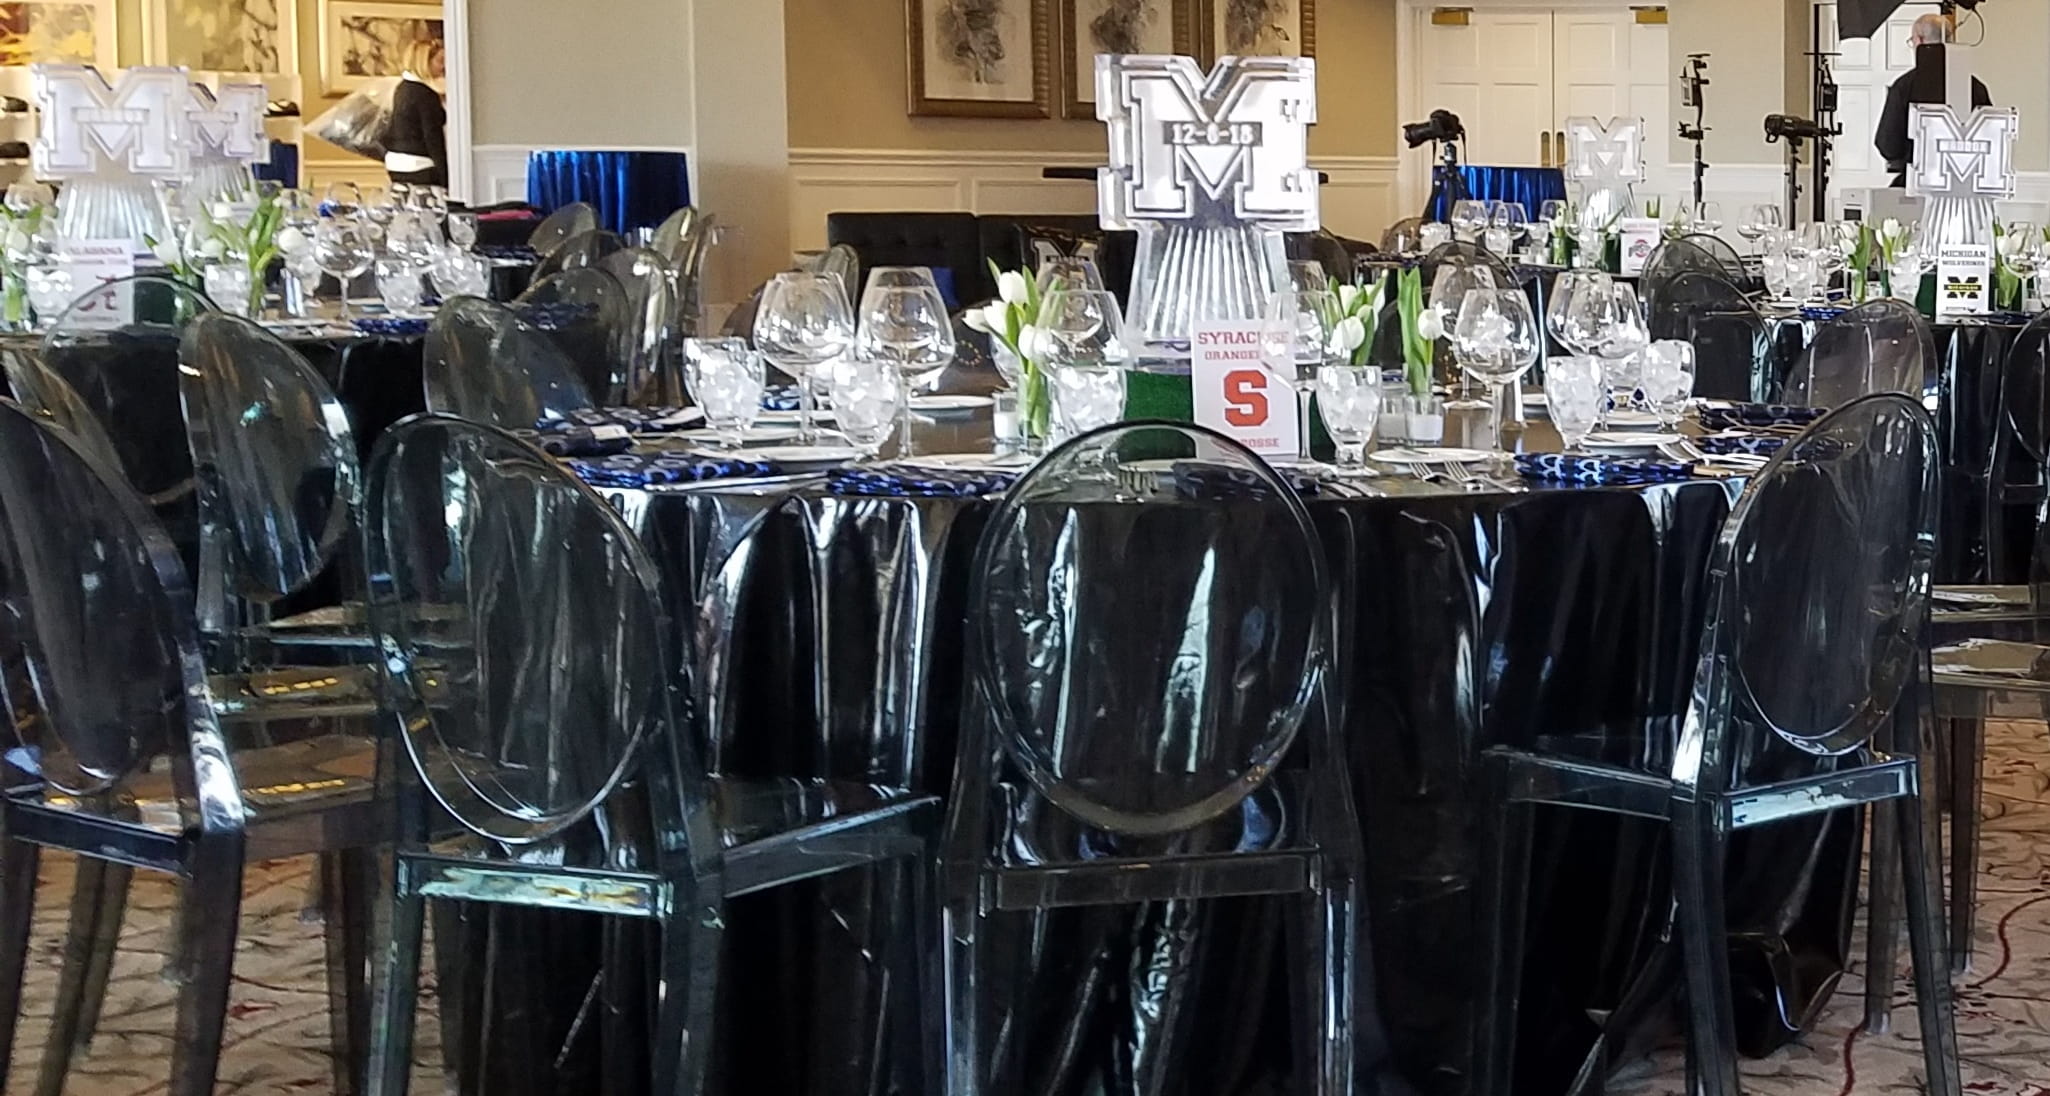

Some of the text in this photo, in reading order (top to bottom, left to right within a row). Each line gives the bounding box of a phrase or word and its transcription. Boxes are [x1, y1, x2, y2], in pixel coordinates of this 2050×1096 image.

[46, 74, 178, 174] M
[1122, 70, 1307, 219] M
[1571, 124, 1639, 179] M
[1915, 110, 2011, 194] M
[1941, 250, 1986, 258] MICHIGAN
[1224, 370, 1268, 427] S
